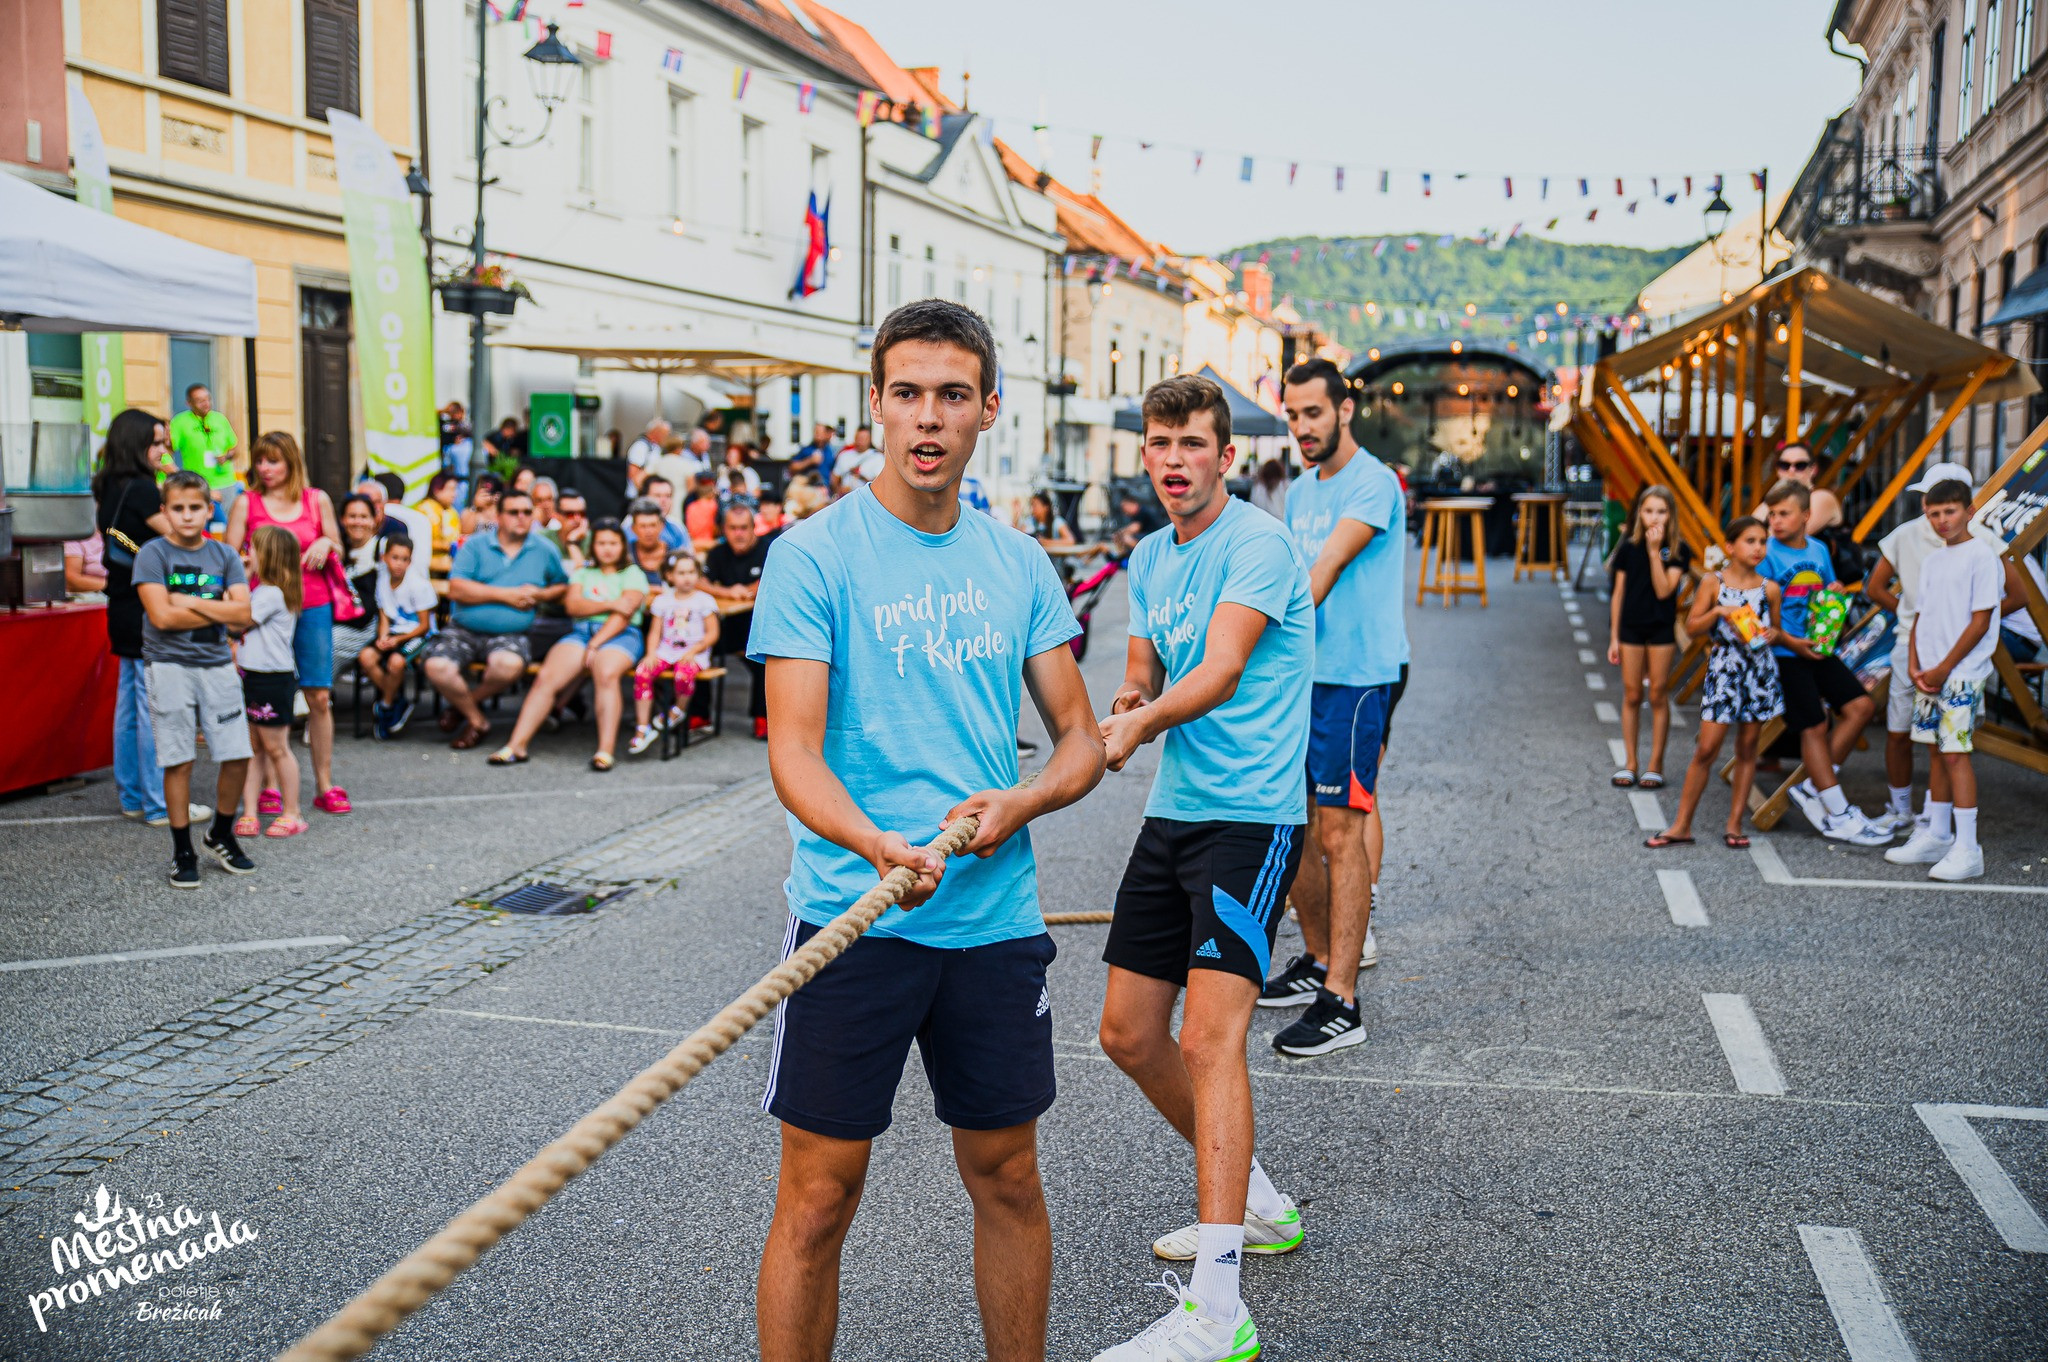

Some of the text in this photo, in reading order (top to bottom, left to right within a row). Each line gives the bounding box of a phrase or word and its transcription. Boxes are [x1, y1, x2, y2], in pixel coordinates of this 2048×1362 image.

[874, 578, 989, 642] prid pele
[890, 634, 914, 678] f
